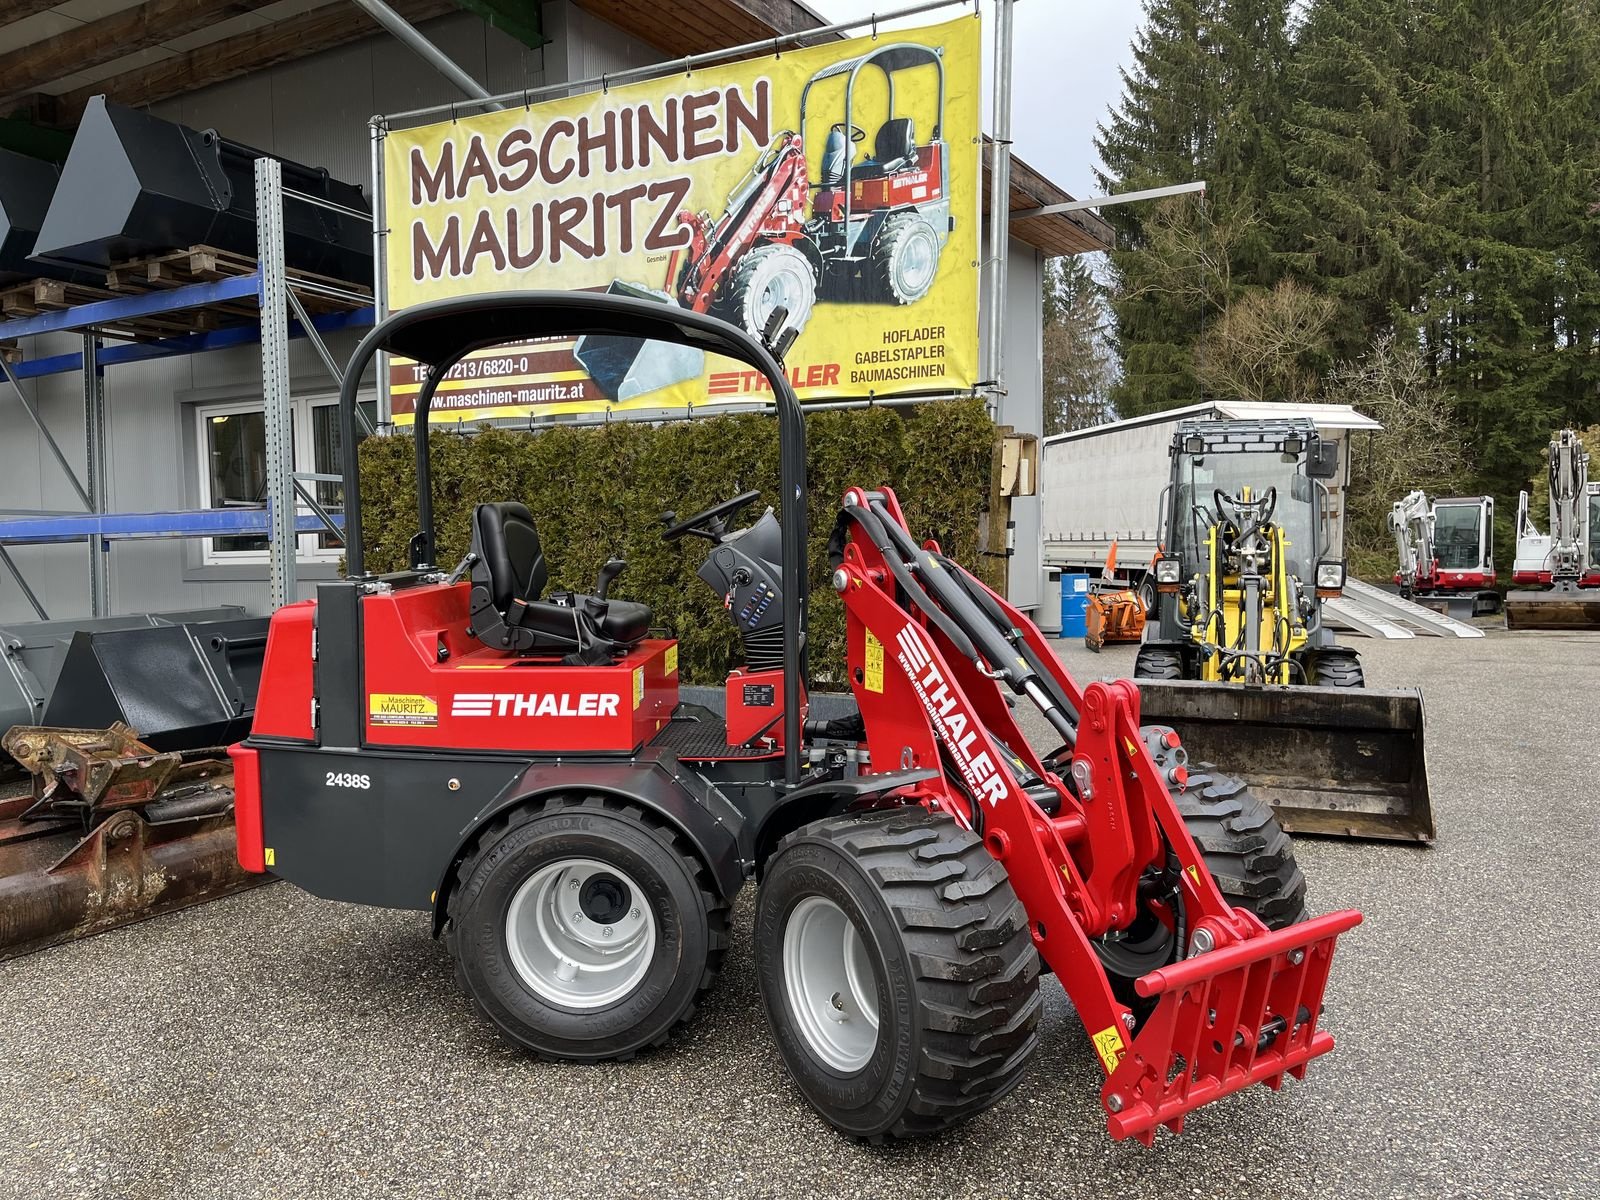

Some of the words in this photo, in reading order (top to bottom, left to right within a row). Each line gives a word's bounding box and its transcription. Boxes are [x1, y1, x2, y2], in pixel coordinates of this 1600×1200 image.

[411, 80, 769, 205] MASCHINEN
[413, 177, 691, 281] MAURITZ
[883, 326, 945, 344] HOFLADER
[855, 345, 945, 364] GABELSTAPLER
[413, 365, 431, 381] TE
[442, 357, 528, 379] 7213/6820-0
[850, 364, 945, 383] BAUMASCHINEN
[413, 382, 584, 409] w.maschinen-mauritz.at
[381, 704, 425, 713] MAURITZ
[494, 693, 620, 717] THALER
[898, 652, 986, 801] www.maschinen-mauritz.at
[922, 662, 1008, 808] THALER
[326, 771, 370, 789] 2438S
